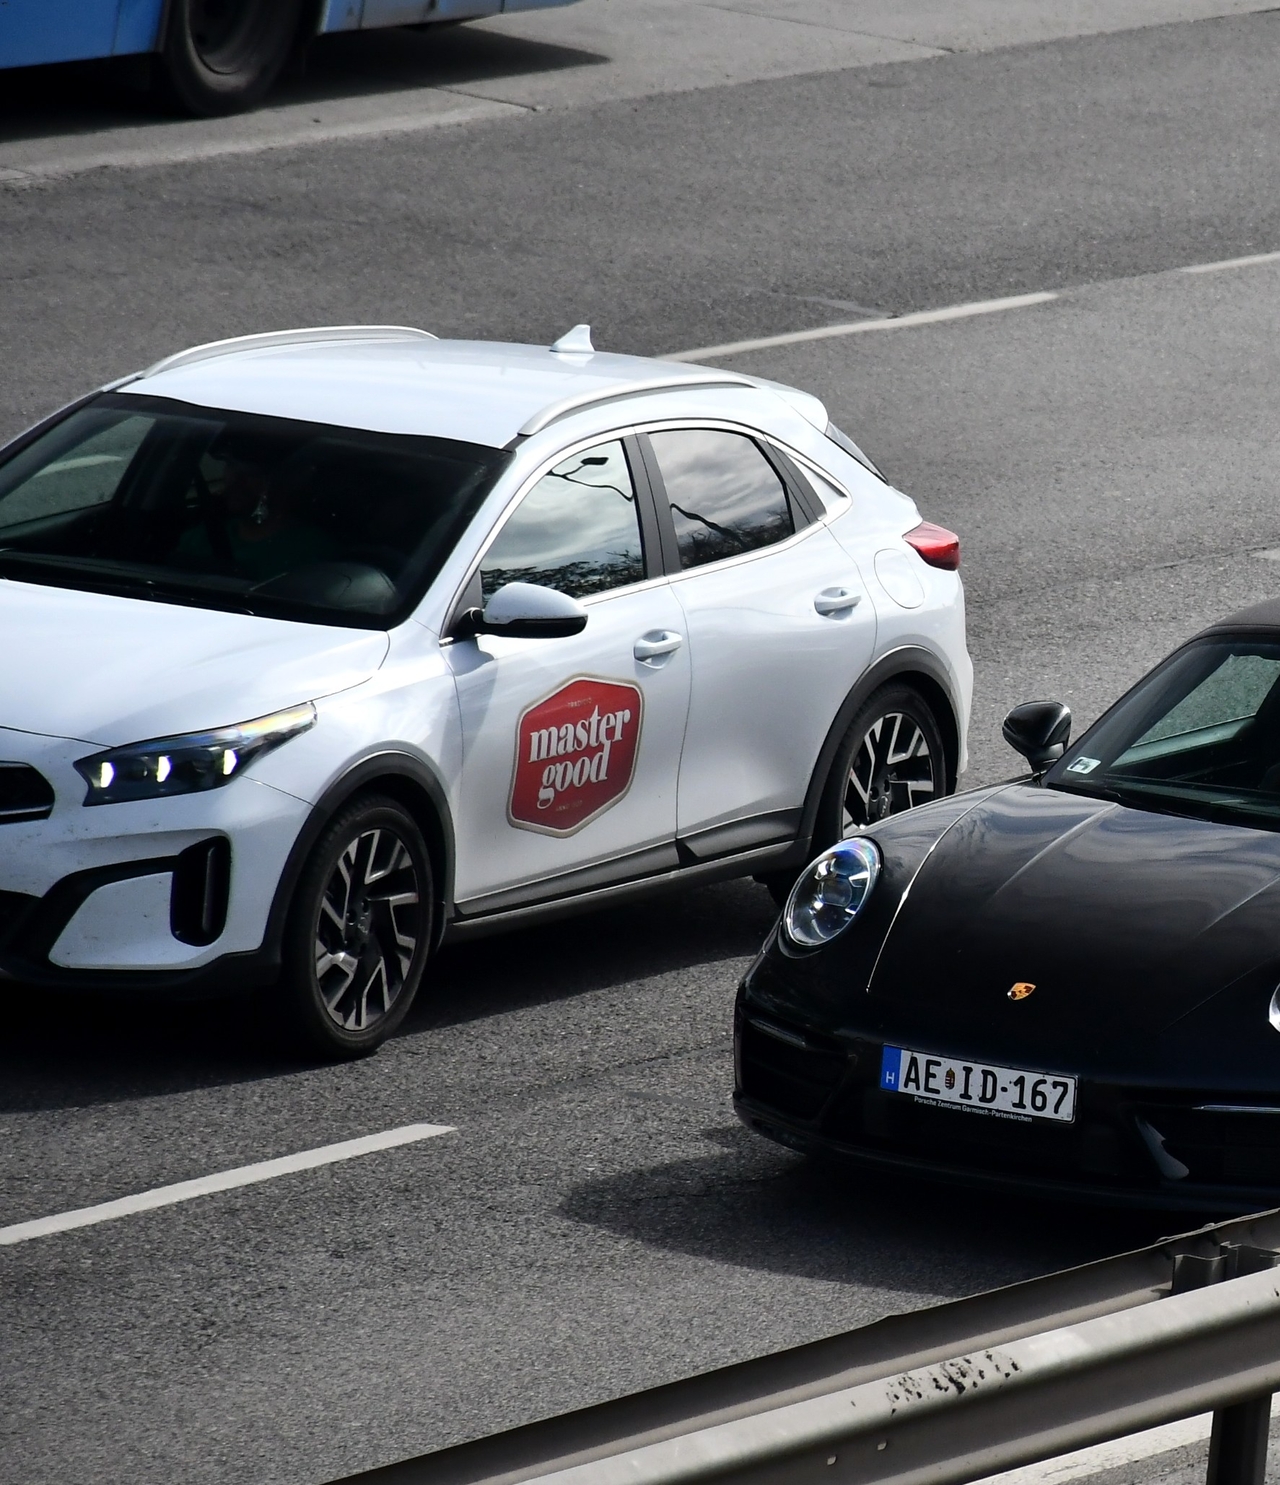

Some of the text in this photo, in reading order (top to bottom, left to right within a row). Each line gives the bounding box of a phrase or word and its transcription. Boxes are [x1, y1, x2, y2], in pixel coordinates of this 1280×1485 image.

[529, 705, 631, 763] master
[537, 741, 611, 809] good
[885, 1071, 895, 1084] H
[914, 1096, 1033, 1123] Porsche Zentrum Garmisch-Partenkirchen
